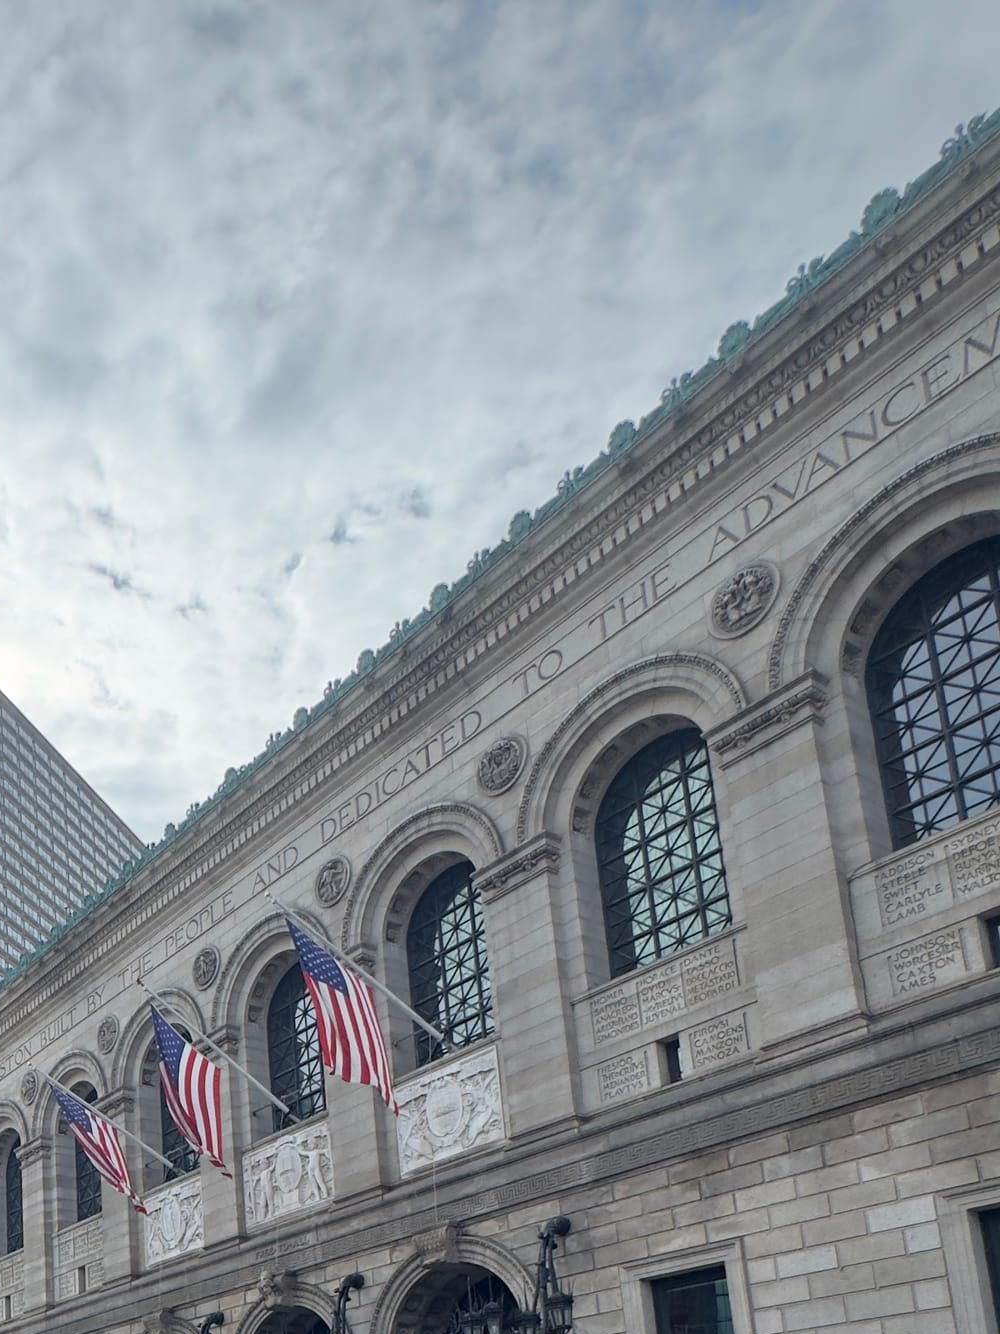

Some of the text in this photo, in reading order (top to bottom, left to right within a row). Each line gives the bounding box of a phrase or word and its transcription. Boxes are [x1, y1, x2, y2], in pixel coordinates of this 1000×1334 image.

[39, 1007, 77, 1048] BUILT
[87, 985, 107, 1015] BY
[118, 951, 155, 989] THE
[164, 890, 236, 958] PEOPLE
[252, 846, 300, 895] AND
[319, 709, 483, 845] DEDICATED
[511, 648, 564, 695] TO
[587, 563, 678, 641] THE
[951, 820, 1000, 850] SYDNEY
[952, 836, 996, 861] DEFOE
[954, 844, 1000, 873] BUNYA
[881, 849, 935, 879] ADDISON
[882, 865, 927, 893] STEELE
[884, 880, 920, 904] SWIFT
[885, 883, 944, 914] CARLYLE
[888, 903, 926, 925] LAMB
[684, 944, 721, 967] DANTE
[894, 930, 956, 962] JOHNSON
[640, 965, 678, 986] HORACE
[897, 954, 956, 983] CAXTON
[900, 972, 937, 993] AMES
[695, 1024, 744, 1048] CAMOENS
[696, 1033, 743, 1058] MANZONI
[697, 1046, 740, 1066] SPINOZA
